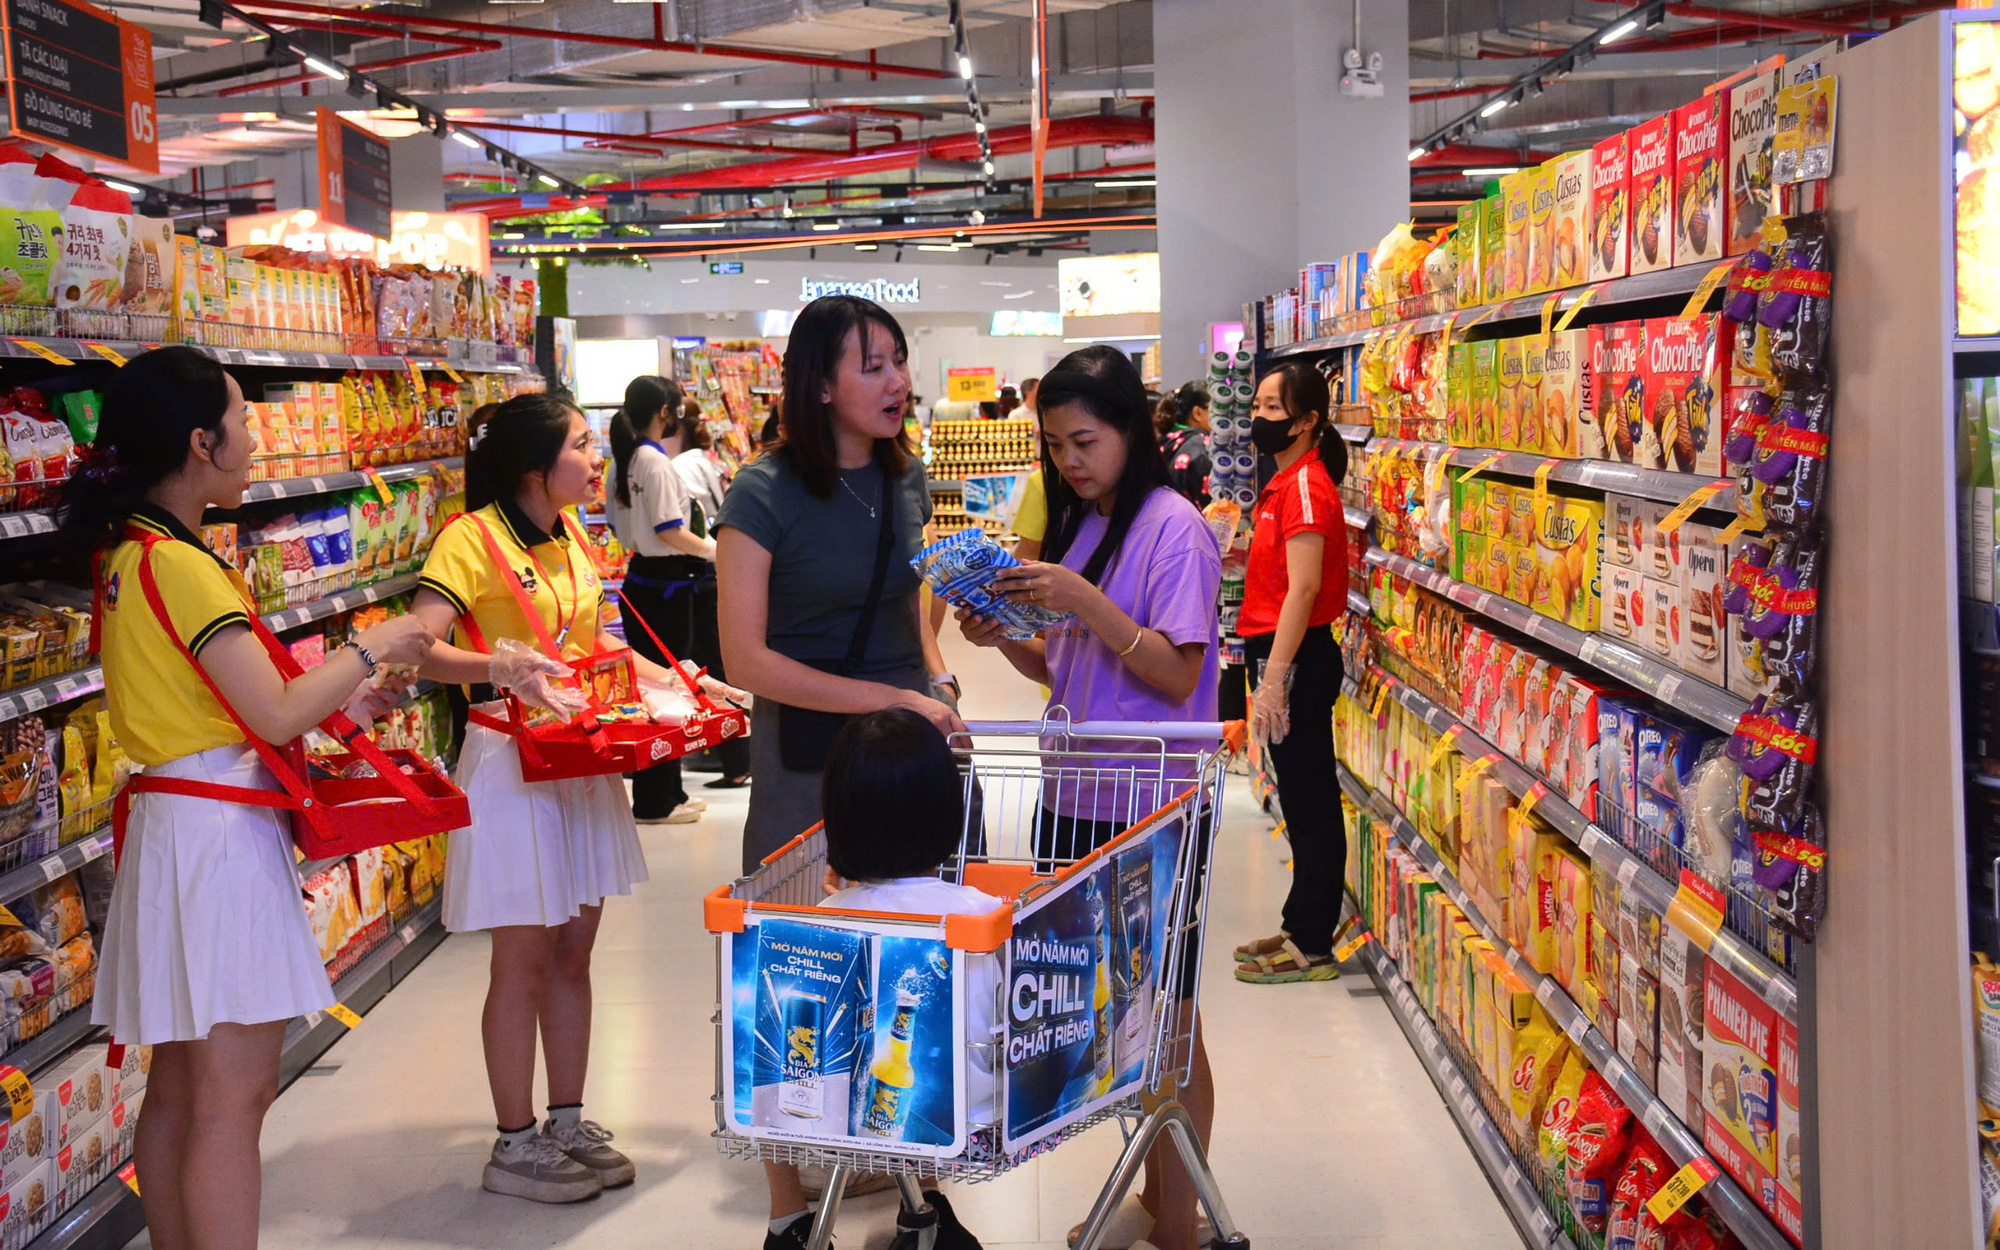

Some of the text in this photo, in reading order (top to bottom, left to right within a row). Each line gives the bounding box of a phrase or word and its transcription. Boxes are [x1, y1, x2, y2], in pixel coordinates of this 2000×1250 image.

[42, 4, 69, 27] SNACK
[40, 96, 63, 119] DÙNG
[64, 107, 82, 126] CHO
[131, 101, 155, 144] 05
[1732, 95, 1777, 142] ChocoPie
[1676, 122, 1718, 161] ChocoPie
[1593, 157, 1624, 189] ChocoPie
[1631, 144, 1666, 177] ChocoPie
[329, 171, 342, 204] 11
[1556, 174, 1582, 203] Custas
[876, 277, 920, 302] Food
[1545, 348, 1570, 372] Custas
[1594, 339, 1637, 374] ChocoPie
[1652, 337, 1703, 374] ChocoPie
[1579, 361, 1592, 425] Custas
[1544, 506, 1576, 545] Custas
[1688, 547, 1715, 577] Opéra
[1598, 714, 1617, 733] OREO
[1638, 730, 1662, 747] OREO
[1637, 802, 1659, 819] OREO
[771, 942, 843, 962] MỞ NĂM MỚI
[787, 955, 824, 970] CHILL
[1016, 934, 1089, 966] MỞ NĂM MỚI
[770, 964, 841, 984] CHẤT RIÊNG
[1012, 973, 1085, 1021] CHILL
[1708, 979, 1769, 1061] PHANER PIE
[1010, 1019, 1089, 1063] CHẤT RIÊNG
[780, 1064, 825, 1082] SAIGON
[795, 1059, 808, 1068] BIA
[1706, 1124, 1741, 1176] PHANER PIE
